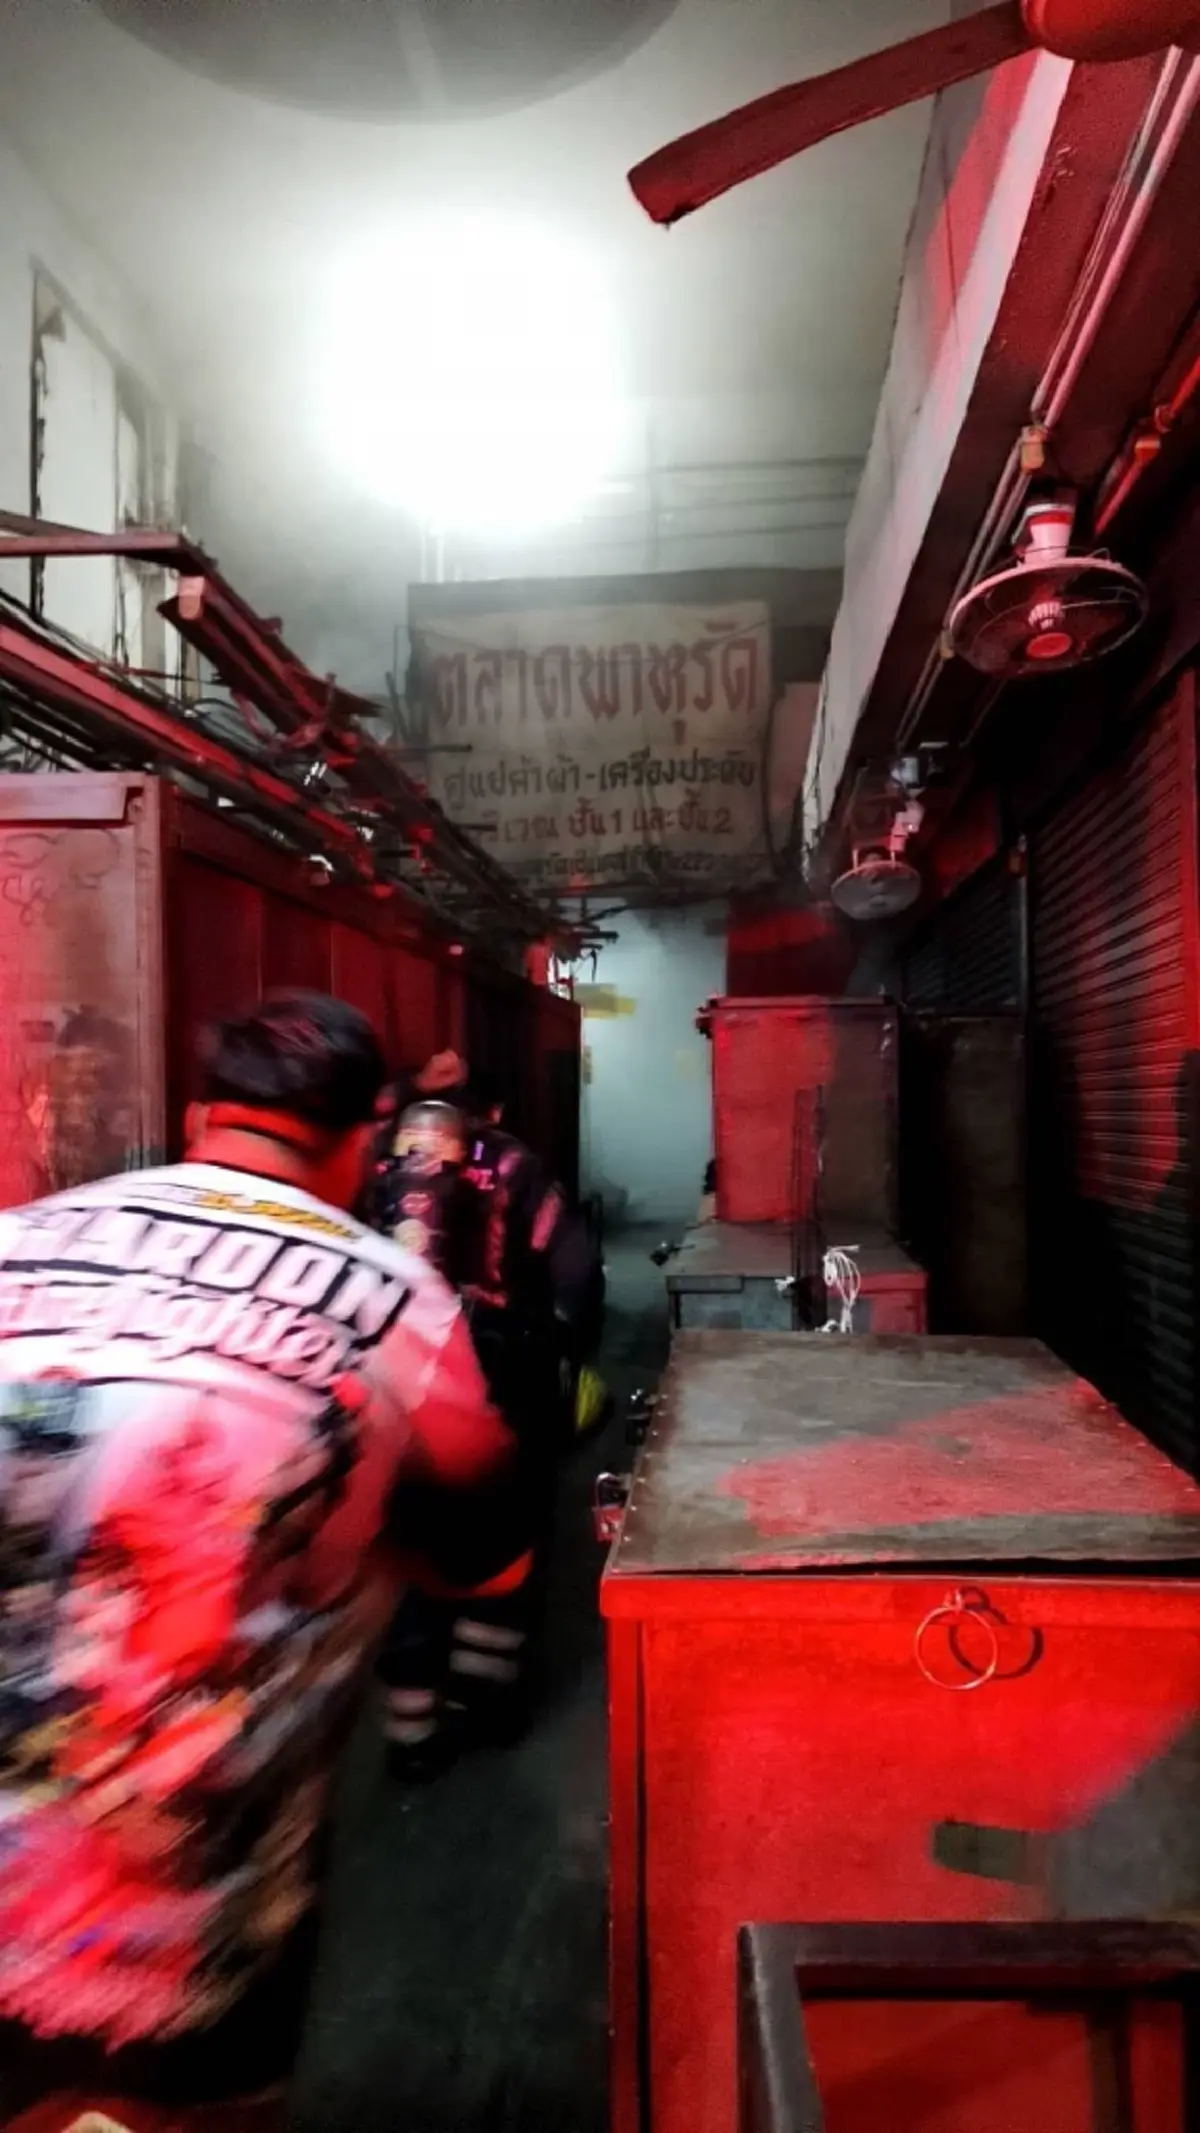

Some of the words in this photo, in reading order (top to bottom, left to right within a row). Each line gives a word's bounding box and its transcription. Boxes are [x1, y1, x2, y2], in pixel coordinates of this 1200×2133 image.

[434, 621, 759, 746] ตลาดพาหุรัด
